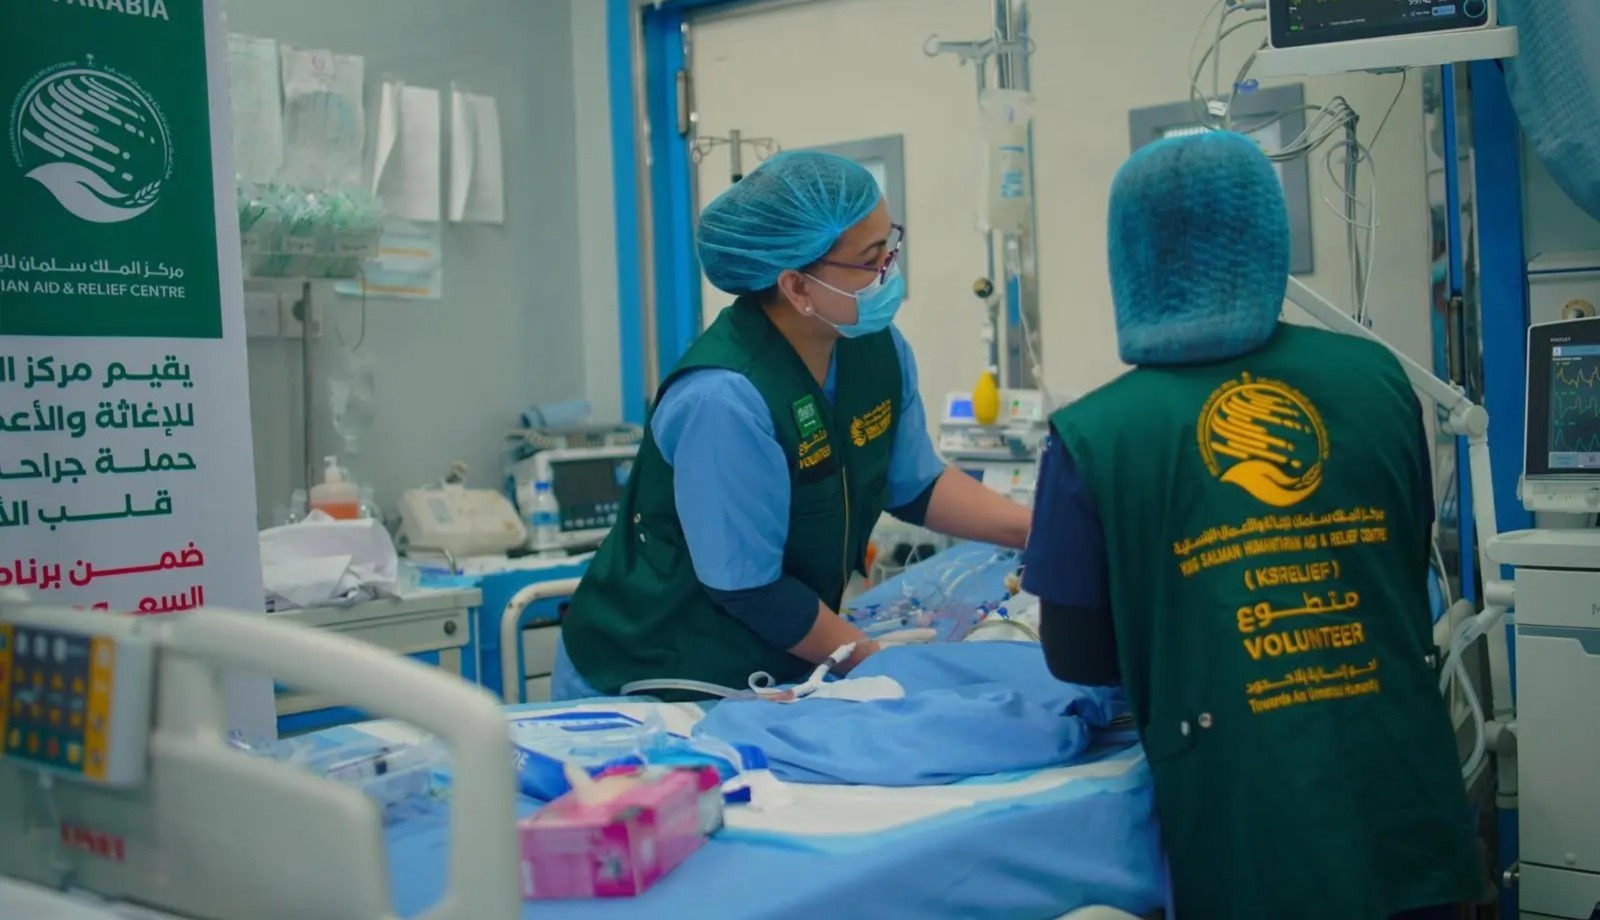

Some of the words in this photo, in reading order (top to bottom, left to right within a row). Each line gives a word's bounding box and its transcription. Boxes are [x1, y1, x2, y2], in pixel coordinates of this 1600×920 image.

[66, 0, 169, 21] ABIA
[19, 255, 87, 272] سلمان
[90, 259, 140, 275] الملك
[143, 261, 184, 279] مركز
[33, 281, 60, 294] AID
[63, 282, 74, 295] &
[78, 283, 127, 296] RELIEF
[130, 284, 186, 298] CENTRE
[24, 355, 92, 388] مركز
[102, 355, 194, 388] يقيم
[95, 399, 194, 437] للإغاثة
[95, 447, 197, 473] حملة
[38, 489, 173, 531] قلب
[69, 541, 204, 586] ضمن
[1236, 591, 1359, 633] متطوع
[1243, 622, 1365, 660] VOLUNTEER
